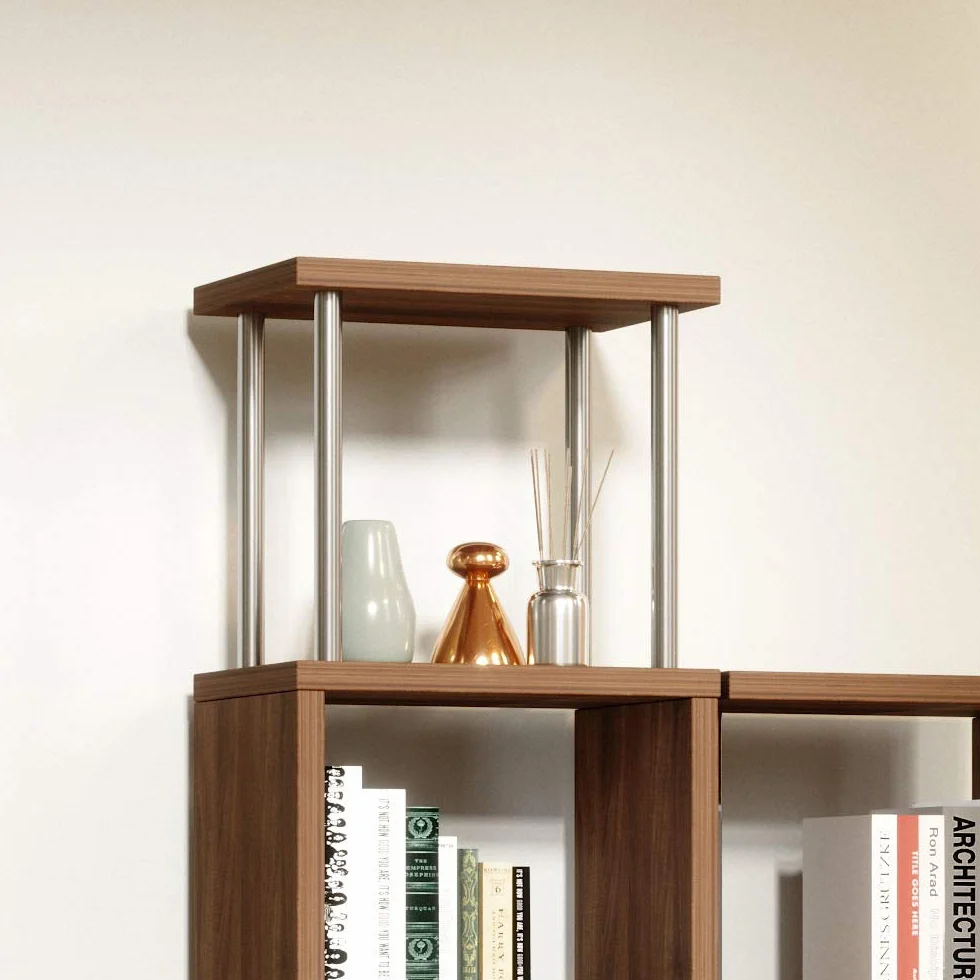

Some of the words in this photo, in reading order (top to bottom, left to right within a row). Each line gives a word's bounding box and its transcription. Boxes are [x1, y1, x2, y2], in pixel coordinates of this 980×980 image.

[929, 827, 939, 857] Ron
[911, 851, 919, 875] TITLE
[495, 885, 502, 893] 6
[911, 879, 919, 908] GOES
[929, 862, 939, 898] Arad
[497, 908, 505, 962] HARRY
[911, 911, 919, 937] HERE
[378, 943, 390, 959] WANT
